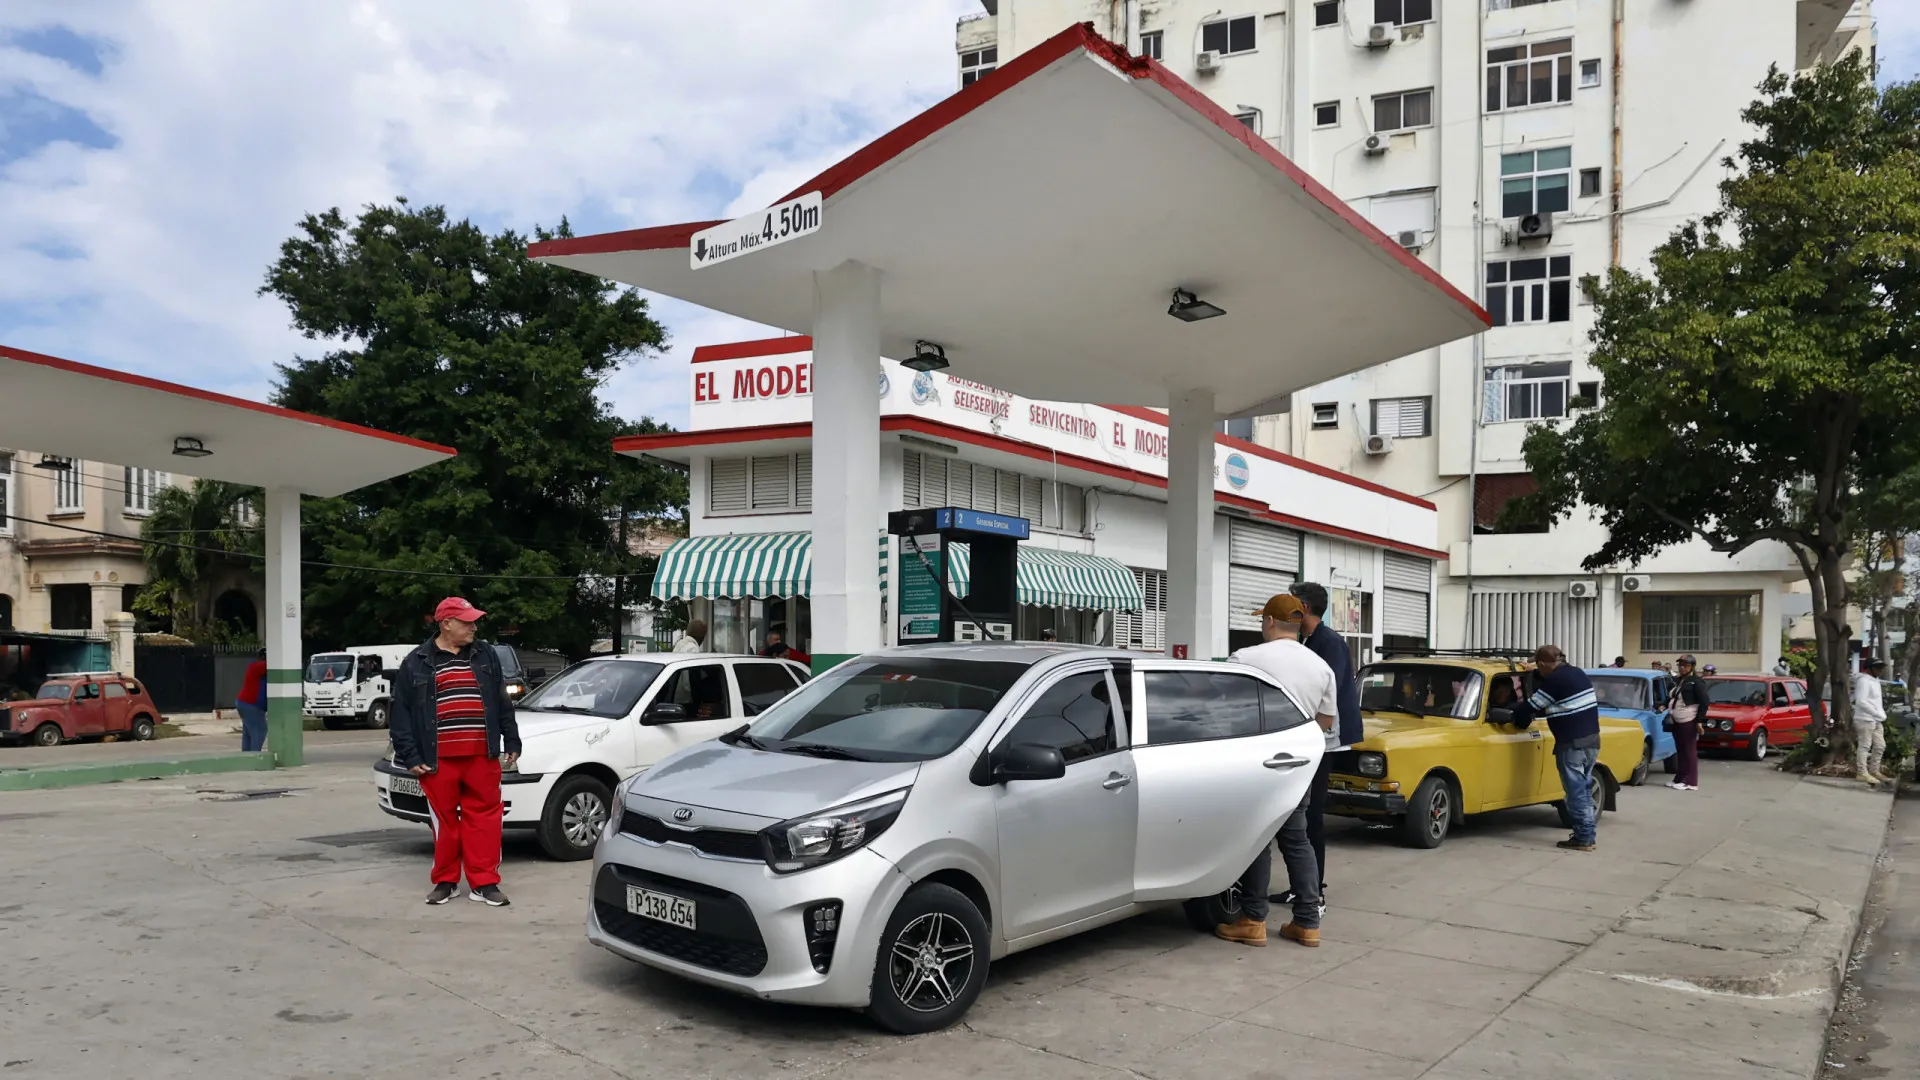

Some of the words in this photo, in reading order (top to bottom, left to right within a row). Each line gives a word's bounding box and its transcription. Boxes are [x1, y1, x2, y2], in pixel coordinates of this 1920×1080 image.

[709, 242, 737, 260] Altura
[740, 232, 763, 250] Máx.
[762, 203, 818, 241] 4.50m
[695, 372, 719, 401] EL
[733, 363, 813, 399] MODE
[954, 390, 1010, 418] SELFSERVICE
[1030, 404, 1096, 439] SERVICENTRO
[1114, 421, 1125, 447] EL
[945, 512, 950, 523] 2
[959, 513, 964, 523] 2
[1021, 524, 1025, 533] 1
[675, 809, 690, 819] KIA
